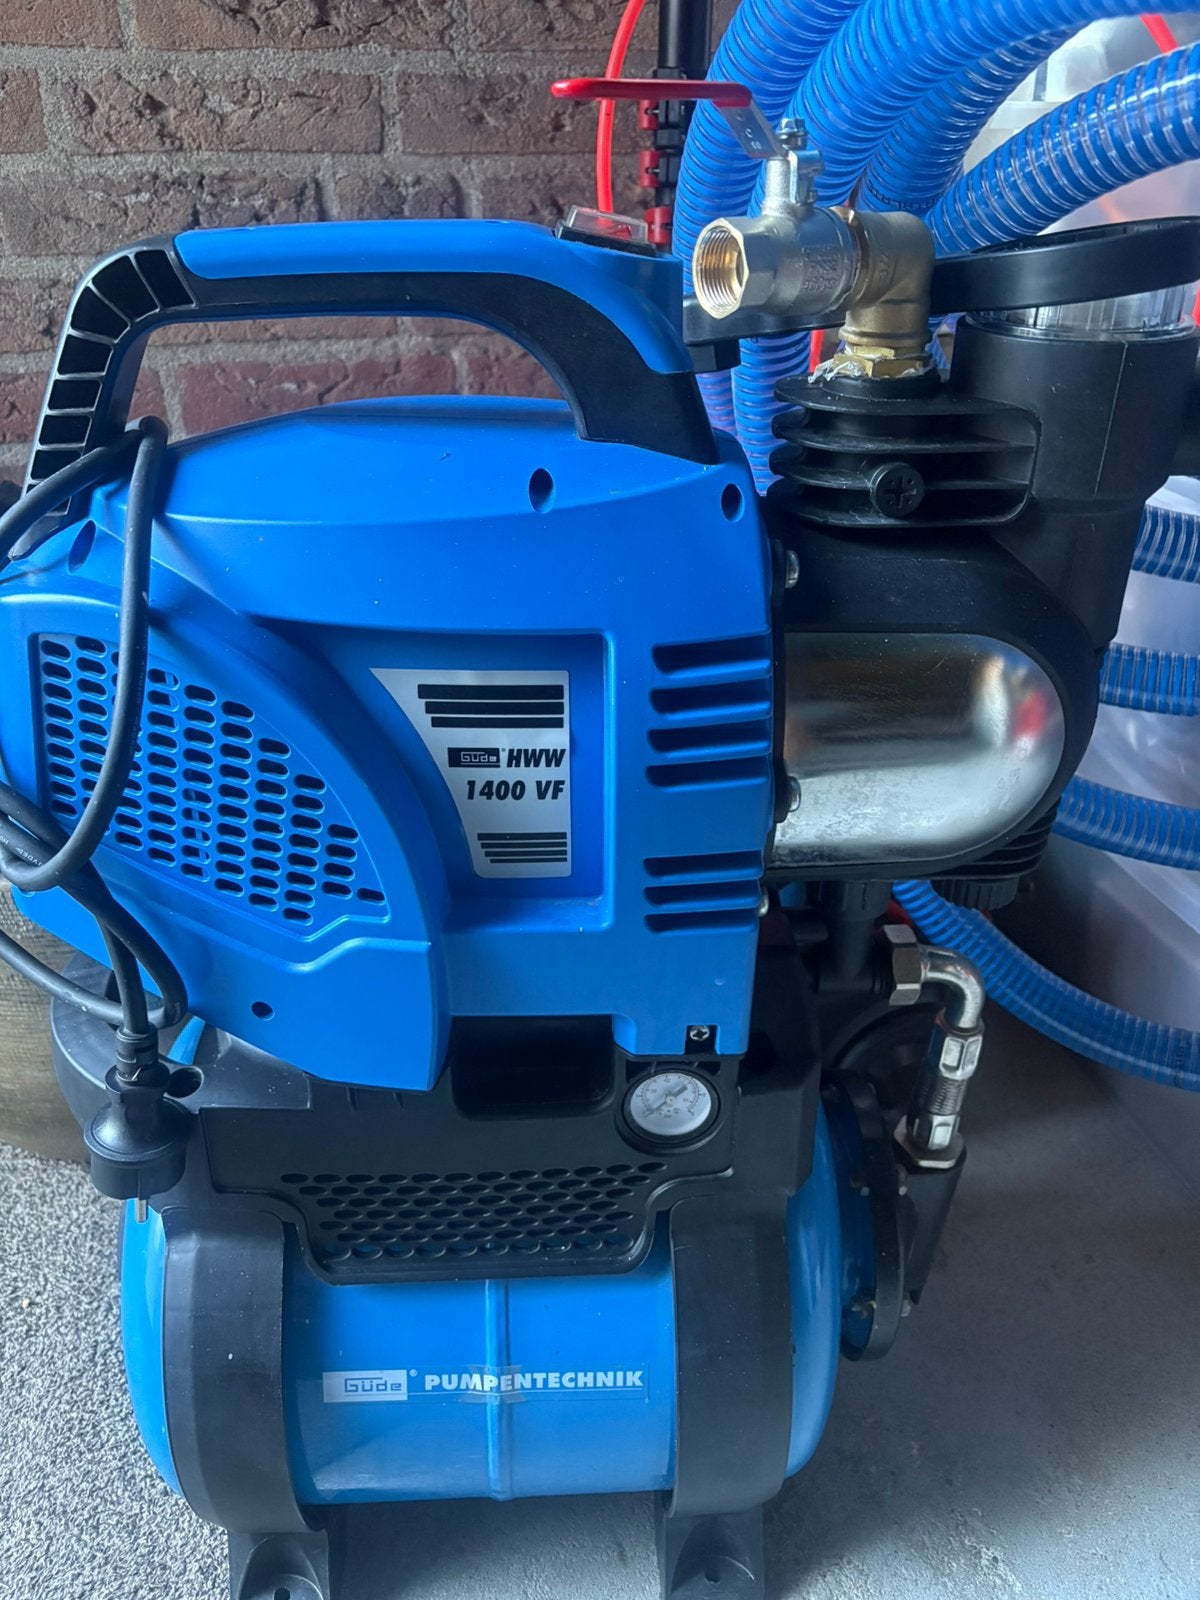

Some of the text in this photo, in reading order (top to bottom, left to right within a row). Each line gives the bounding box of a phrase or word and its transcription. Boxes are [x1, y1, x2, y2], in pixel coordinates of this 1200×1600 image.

[506, 748, 566, 768] HWW
[467, 780, 566, 801] 1400 VF
[424, 1371, 643, 1390] PUMPENTECHNIK
